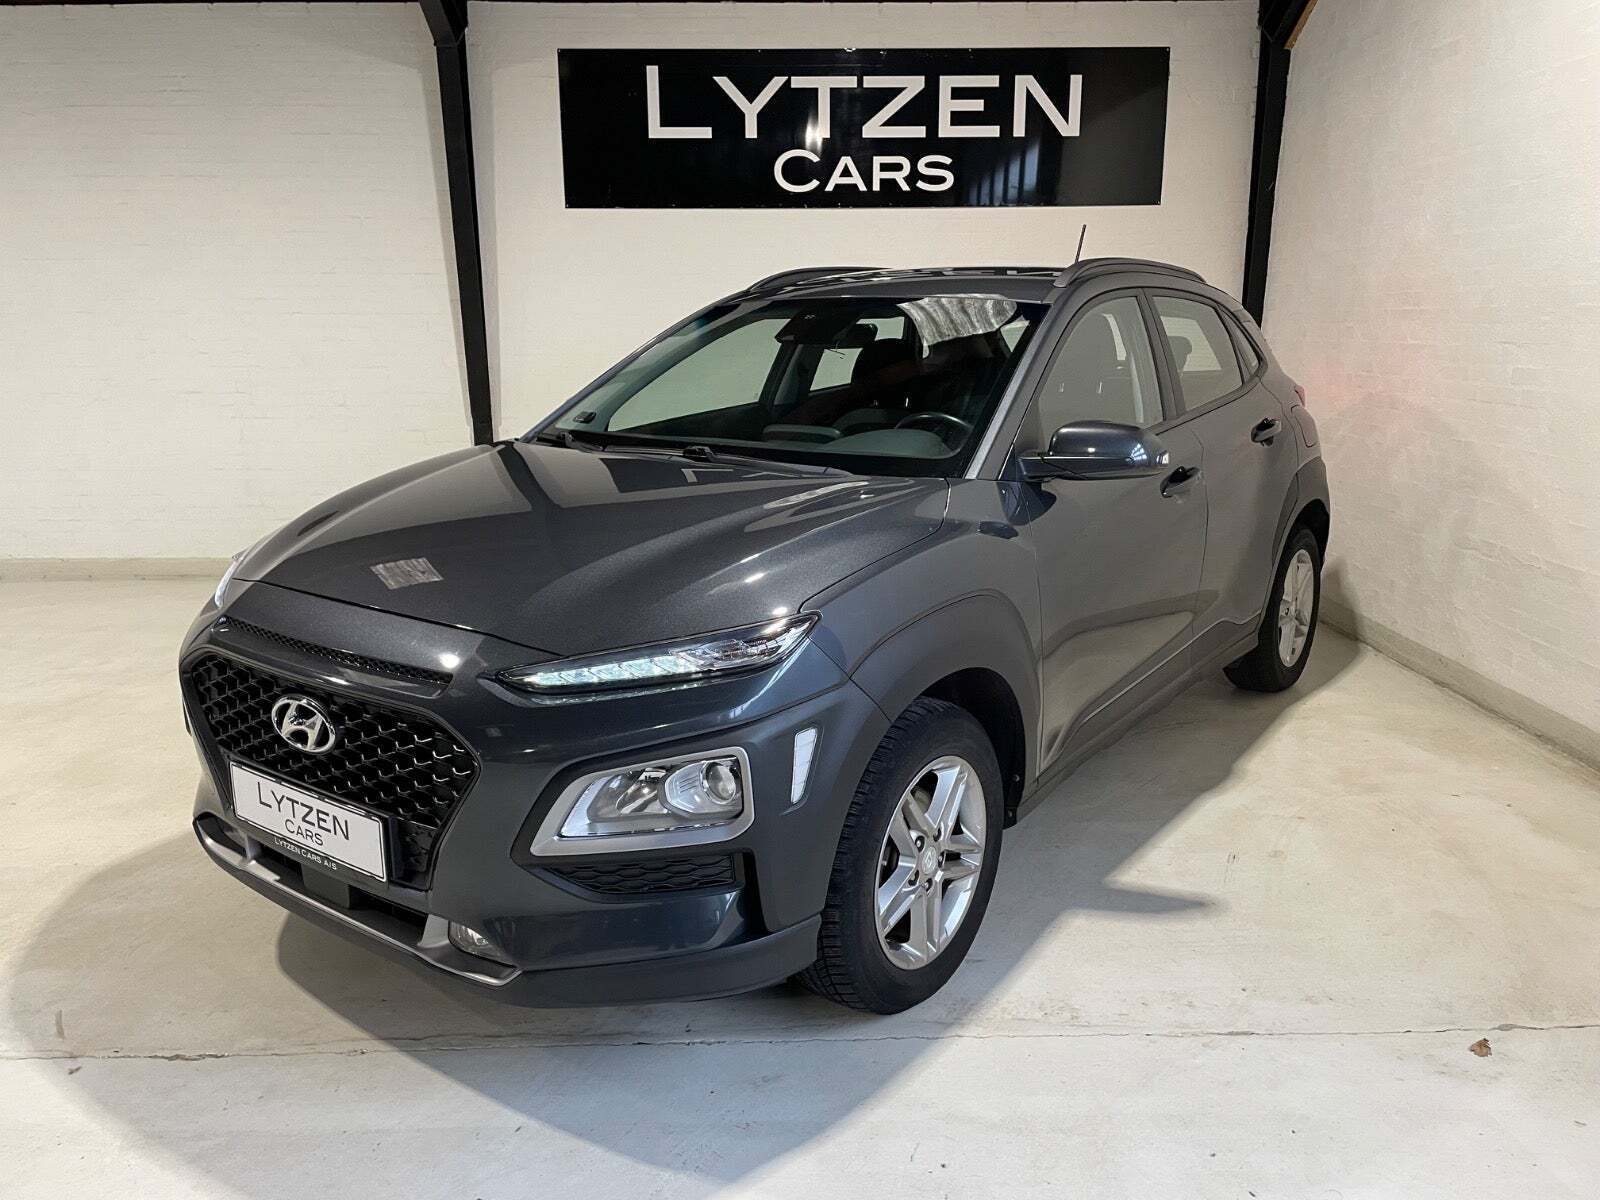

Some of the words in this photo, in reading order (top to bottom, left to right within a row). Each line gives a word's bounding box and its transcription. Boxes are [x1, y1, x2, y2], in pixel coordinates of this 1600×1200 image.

[645, 65, 1083, 139] LYTZEN
[773, 149, 955, 193] CARS
[257, 781, 350, 841] LYTZEN
[284, 819, 324, 847] CARS
[274, 837, 301, 855] LYTZEN
[301, 849, 322, 864] CARS
